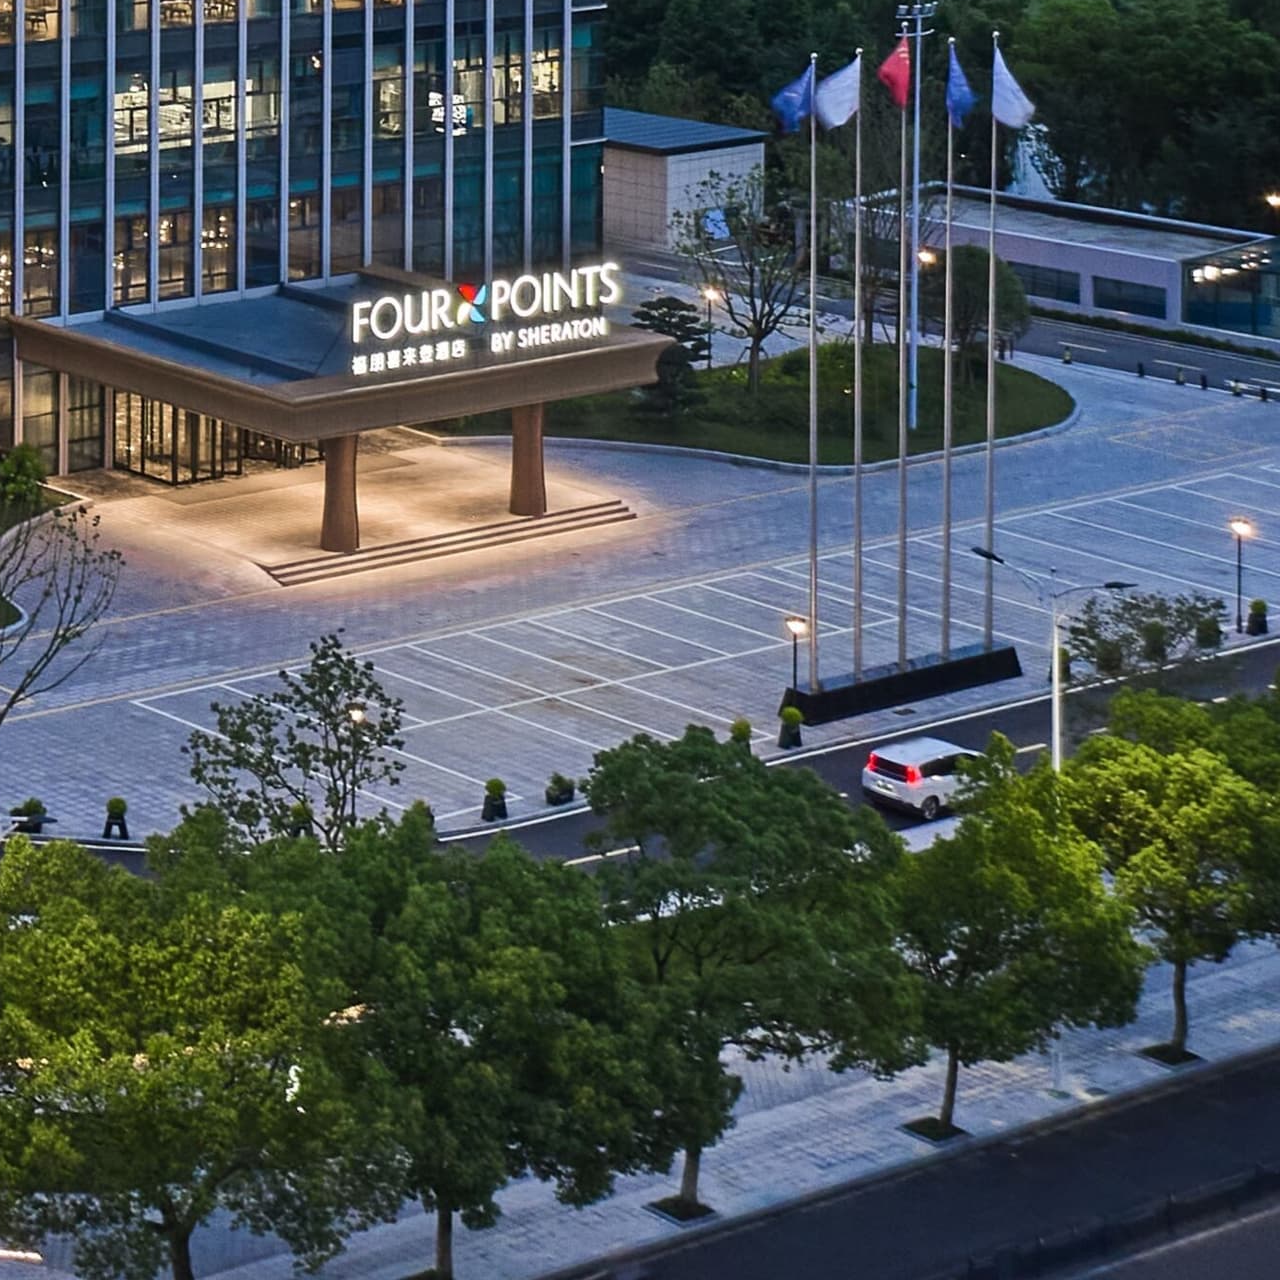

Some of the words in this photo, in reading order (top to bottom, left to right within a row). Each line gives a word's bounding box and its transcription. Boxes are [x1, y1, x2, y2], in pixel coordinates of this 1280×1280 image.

[351, 288, 455, 343] FOUR
[491, 261, 622, 321] POINTS
[491, 331, 513, 353] BY
[518, 316, 608, 349] SHERATON
[350, 339, 466, 376] 福朋喜来登酒店
